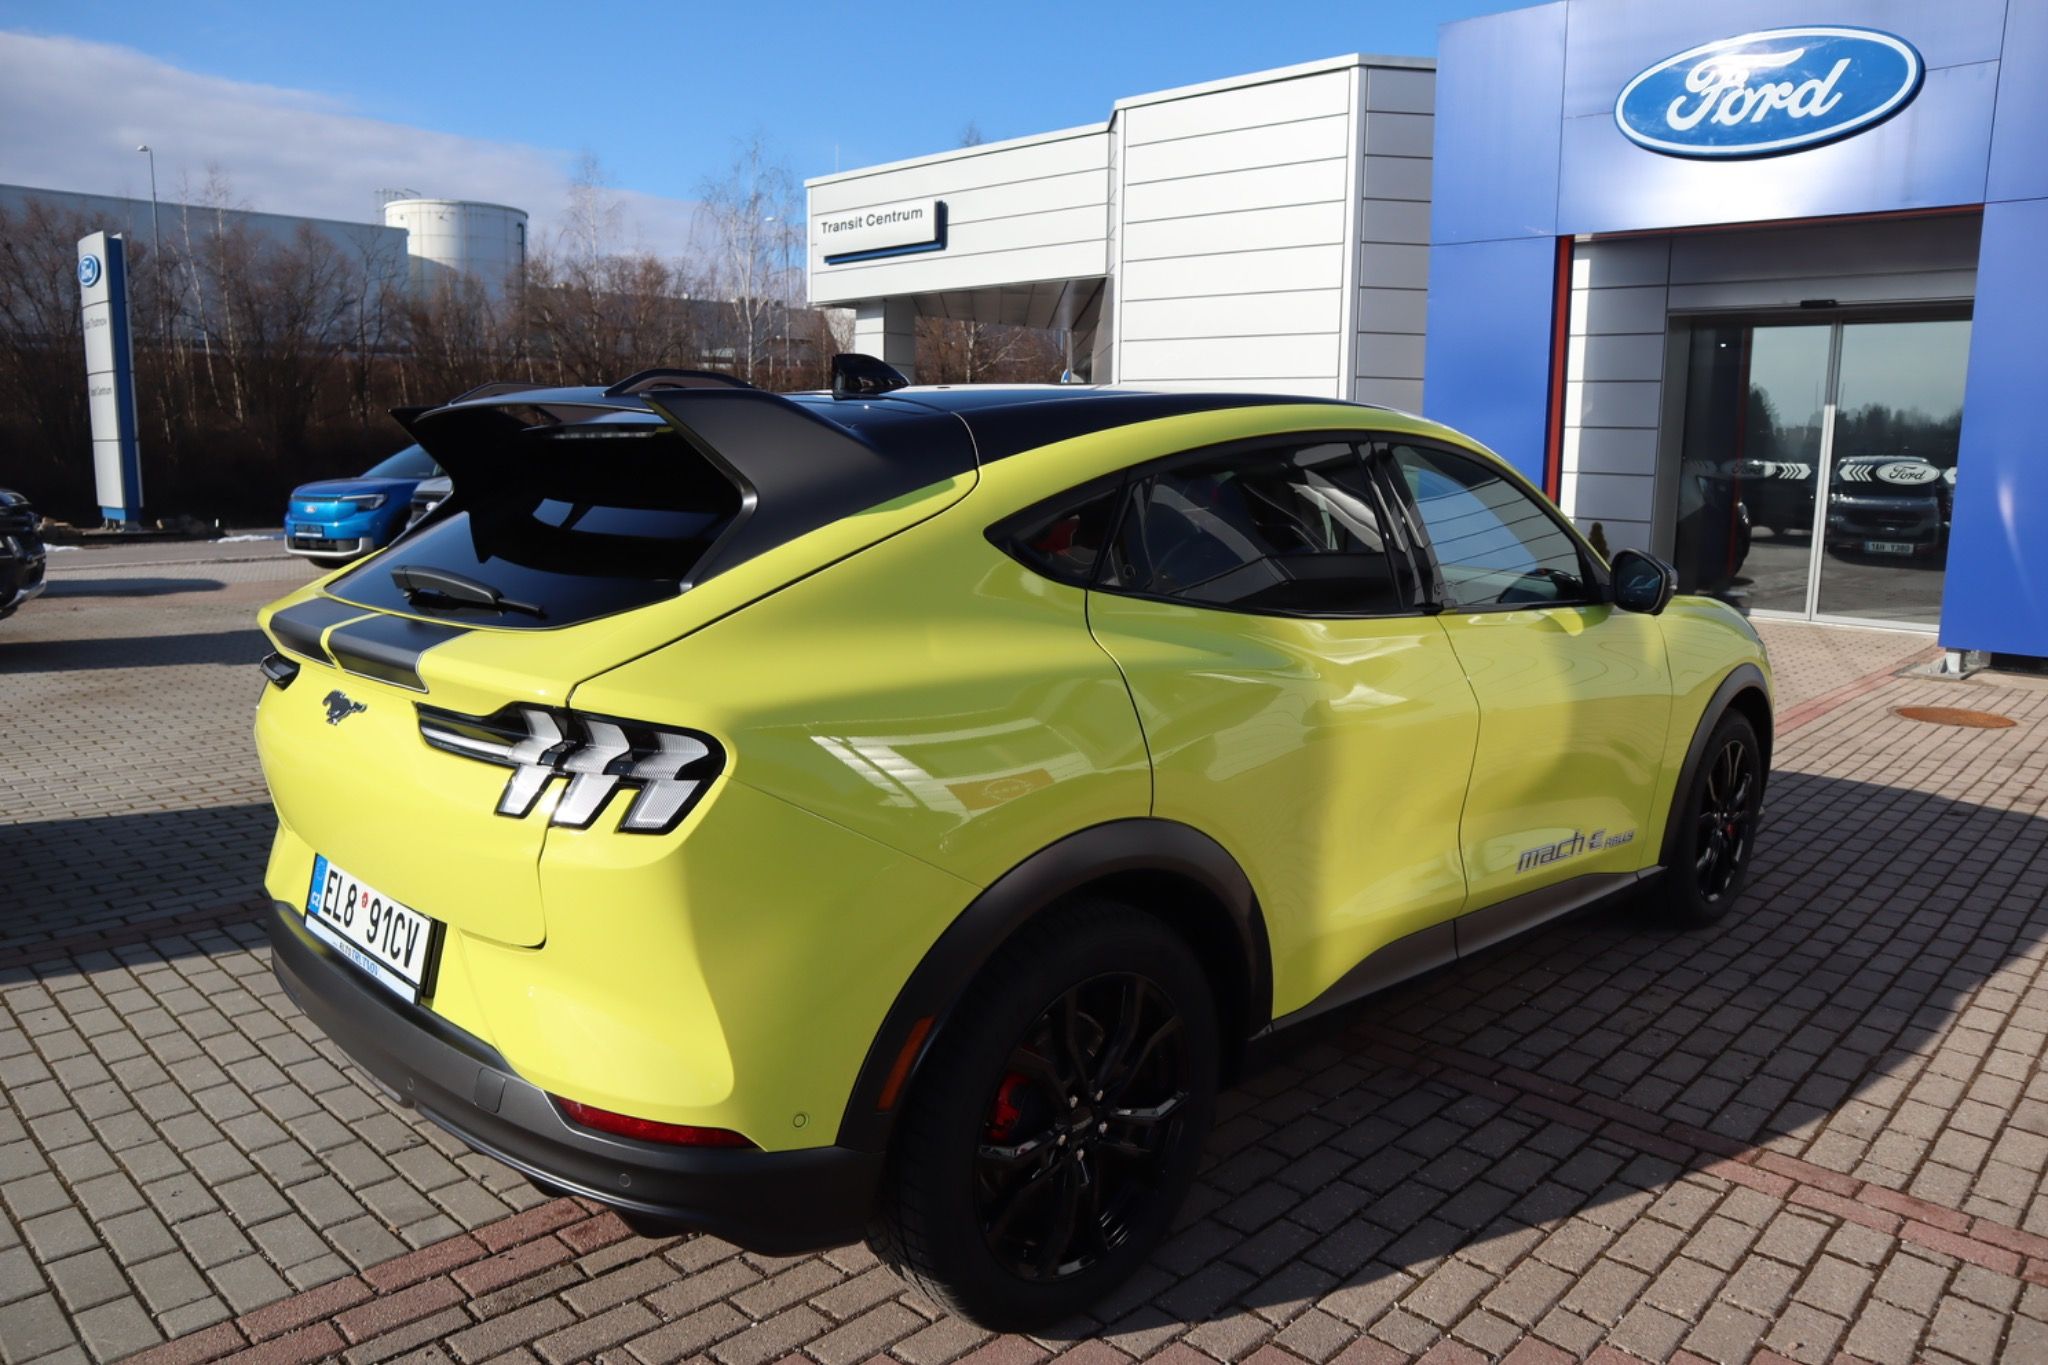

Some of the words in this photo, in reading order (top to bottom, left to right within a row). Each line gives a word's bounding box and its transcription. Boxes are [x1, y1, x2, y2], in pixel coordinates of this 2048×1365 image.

[1666, 47, 1852, 131] Ford
[821, 216, 863, 234] Transit
[866, 208, 923, 227] Centrum
[1889, 465, 1926, 480] Ford
[1516, 829, 1585, 874] mach
[322, 868, 358, 929] EL8
[366, 897, 420, 969] 91CV
